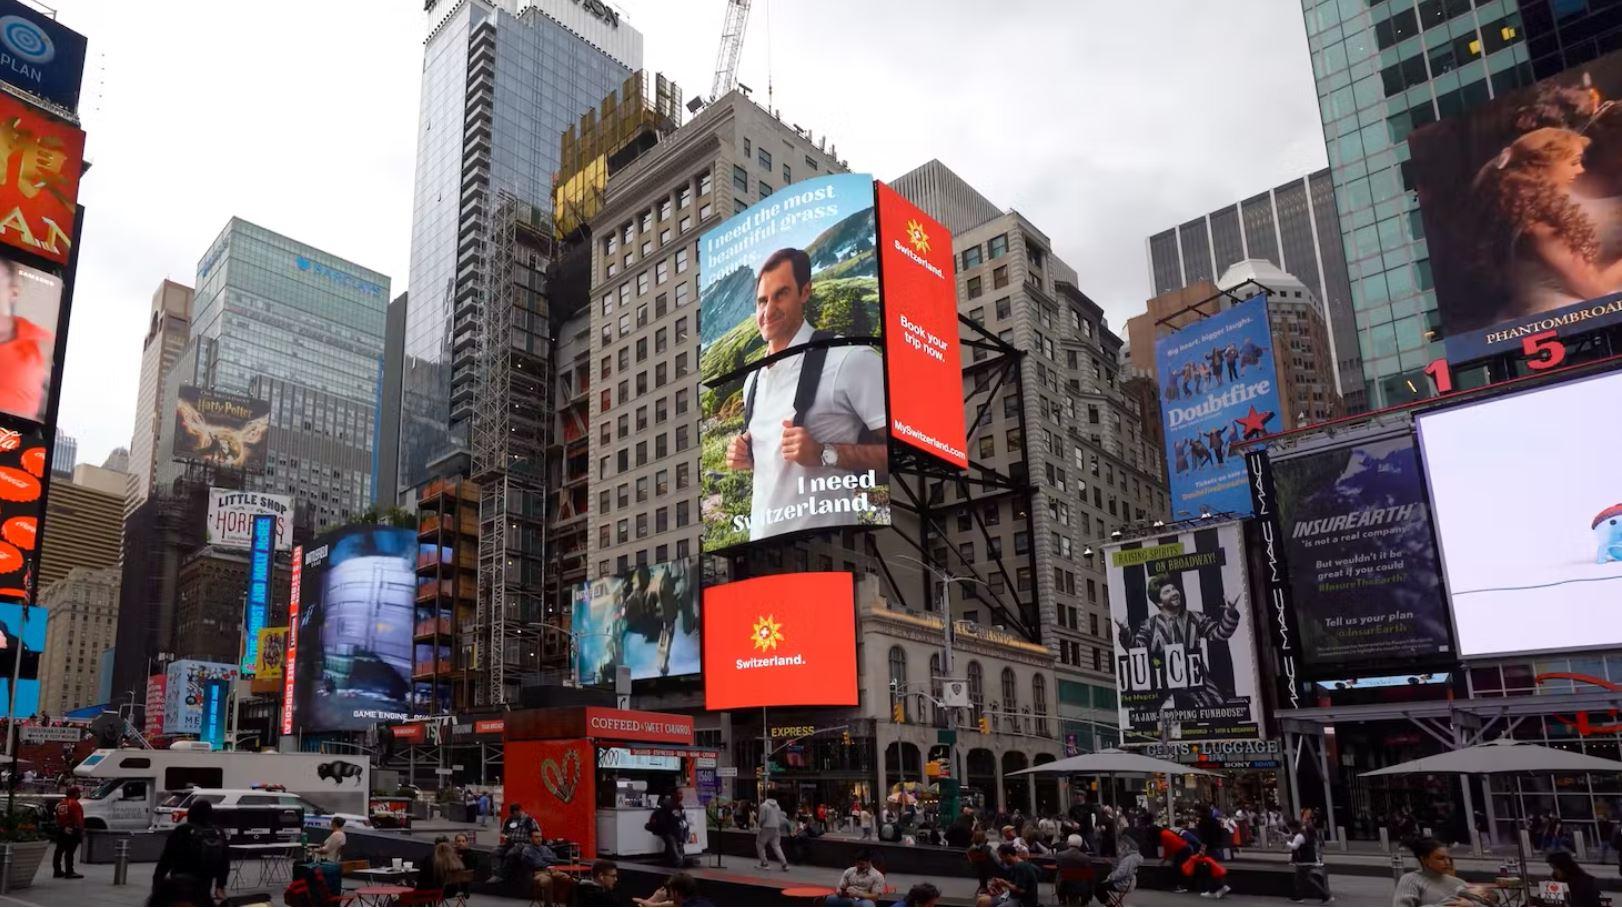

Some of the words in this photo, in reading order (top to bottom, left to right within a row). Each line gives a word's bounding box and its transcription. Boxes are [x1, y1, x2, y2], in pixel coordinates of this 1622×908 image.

[1, 53, 42, 83] PLAN
[707, 238, 712, 252] I
[715, 216, 752, 249] need
[754, 202, 781, 227] the
[783, 184, 836, 211] most
[708, 221, 777, 268] beautiful
[780, 204, 838, 233] grass
[894, 239, 945, 279] Switzerland.
[900, 314, 926, 339] Book
[927, 332, 948, 351] your
[904, 331, 922, 350] trip
[923, 342, 946, 363] now.
[1424, 357, 1452, 392] 1
[1521, 329, 1567, 370] 5
[198, 399, 224, 414] Harry
[225, 401, 253, 418] Potter
[1168, 380, 1271, 428] Doubtfire
[894, 419, 966, 460] MySwitzerland.com
[797, 476, 805, 494] I
[810, 469, 876, 493] need
[218, 493, 258, 508] LITTLE
[259, 496, 287, 516] SHOP
[733, 492, 877, 533] Switzerland.
[1314, 536, 1331, 546] not
[1340, 532, 1360, 542] real
[1118, 550, 1149, 564] RAISING
[1149, 544, 1180, 559] SPIRITS
[1155, 562, 1167, 573] ON
[1168, 552, 1217, 571] BROADWAY!
[1315, 559, 1333, 569] But
[1334, 552, 1378, 566] wouldn't
[1379, 551, 1388, 560] it
[1389, 550, 1402, 559] be
[253, 552, 269, 581] MOLLY
[1317, 568, 1344, 582] great
[1345, 566, 1353, 578] if
[1355, 566, 1375, 577] you
[1376, 560, 1405, 572] could
[252, 583, 267, 603] AND
[1324, 616, 1344, 628] Tell
[1345, 617, 1358, 625] us
[1359, 613, 1387, 626] your
[1388, 610, 1415, 623] plan
[736, 654, 806, 670] Switzerland.
[353, 710, 377, 719] GAME
[378, 711, 409, 720] ENGINE
[591, 716, 640, 732] COFFEED
[425, 718, 443, 746] TSX
[771, 726, 815, 738] EXPRESS
[1201, 740, 1279, 755] LUGGAGE
